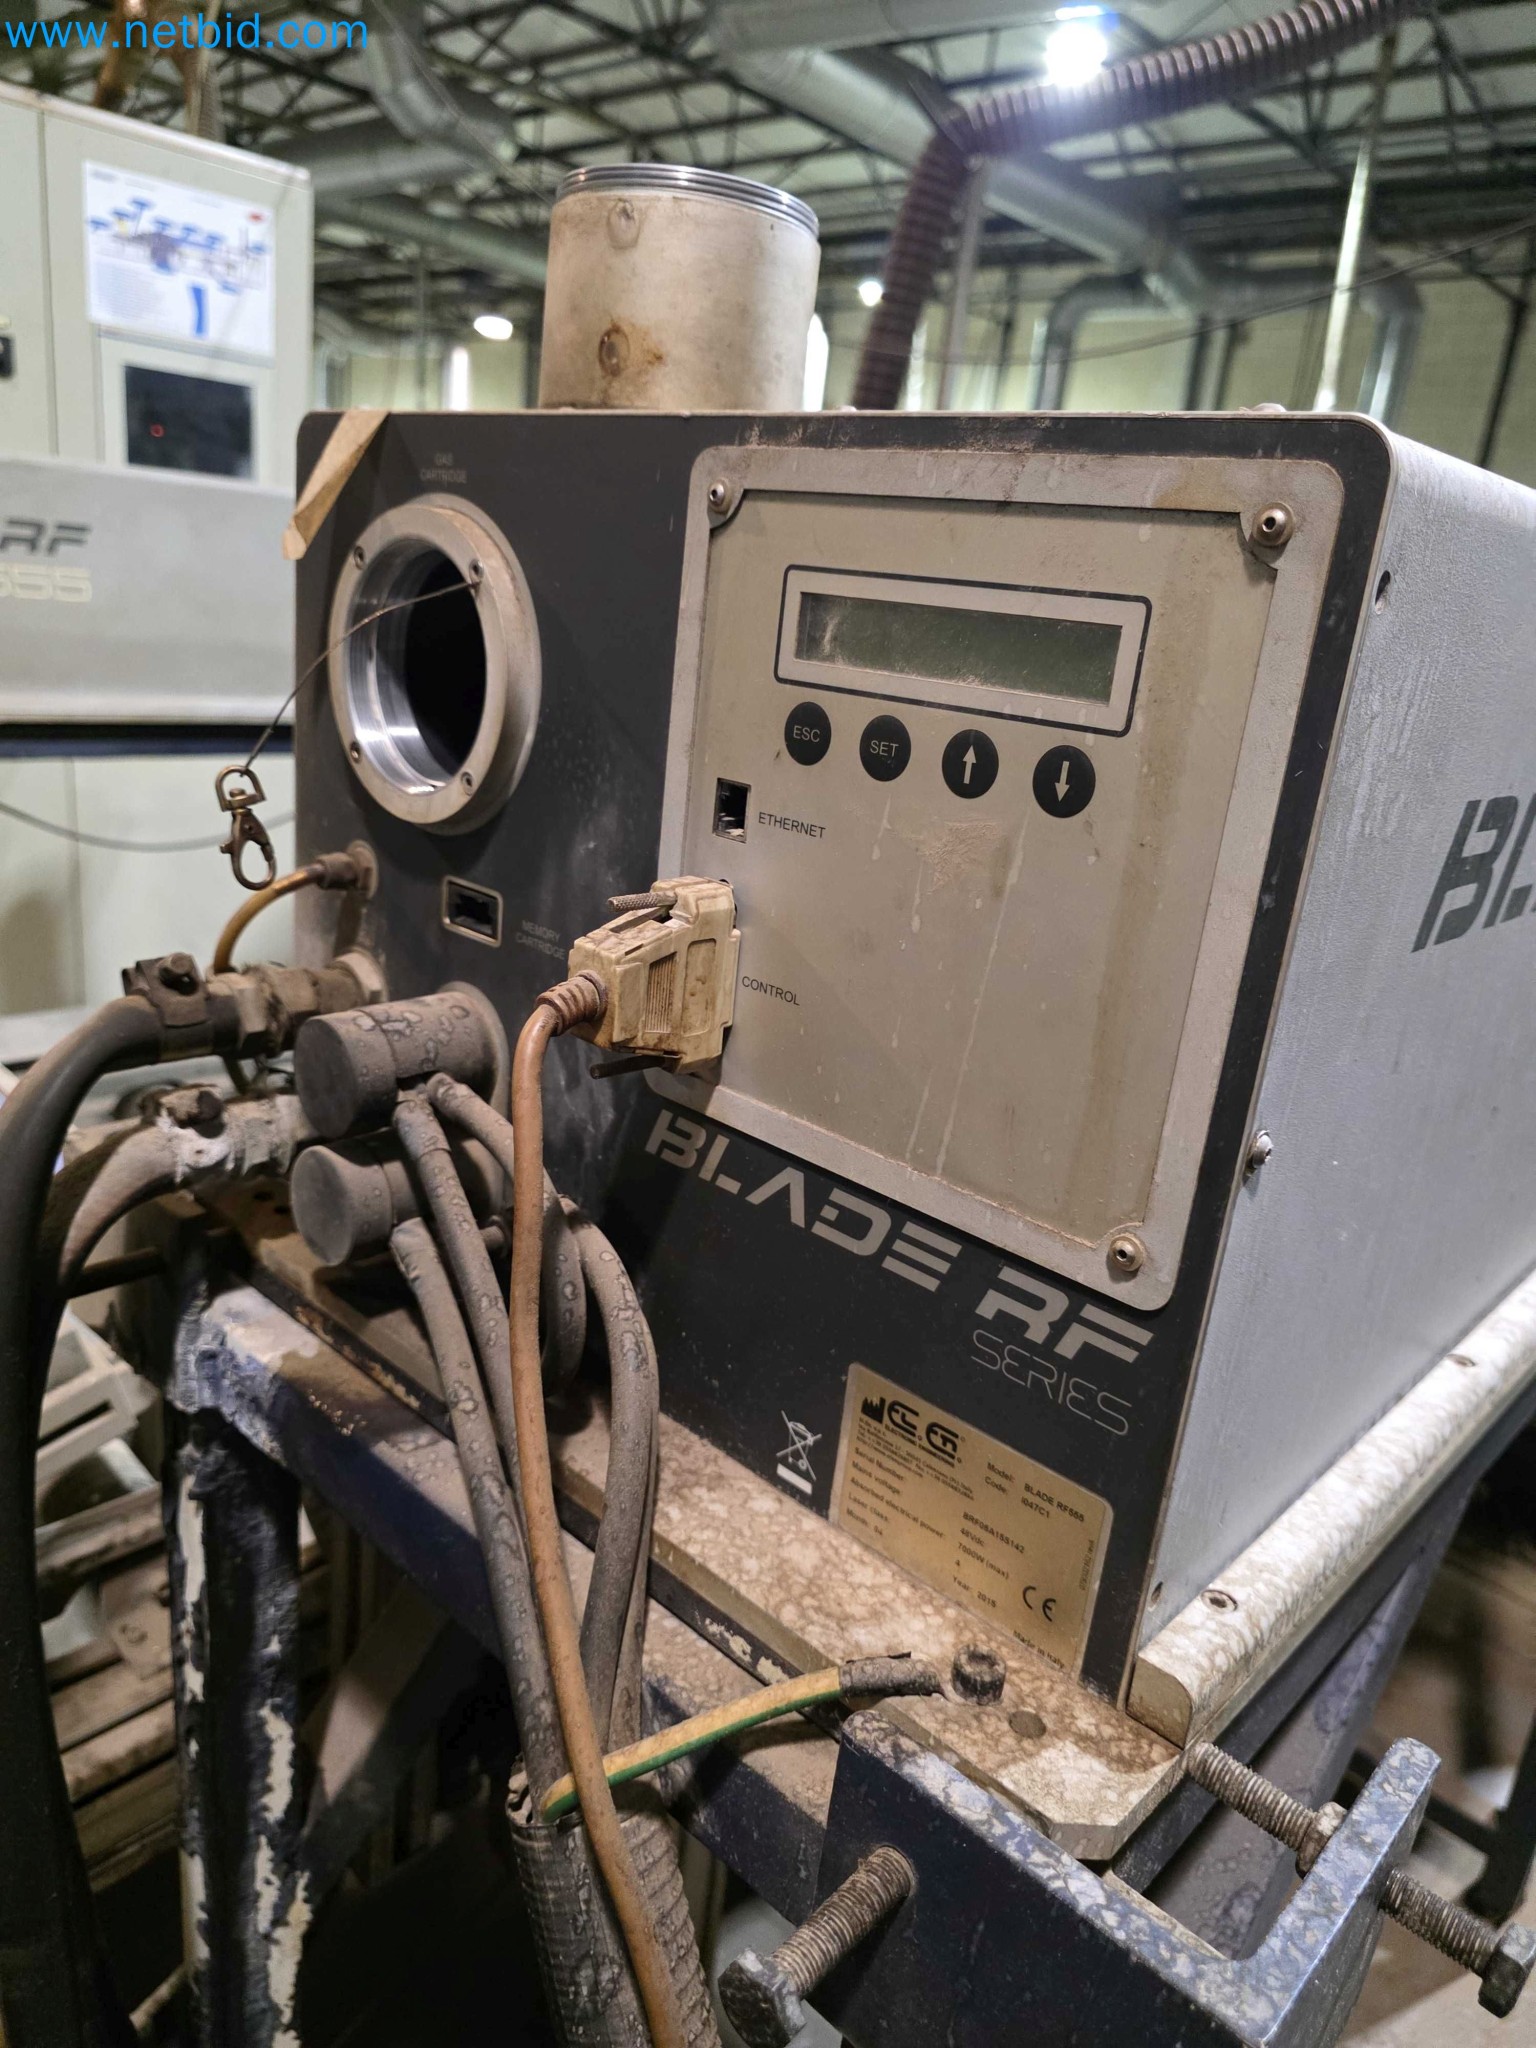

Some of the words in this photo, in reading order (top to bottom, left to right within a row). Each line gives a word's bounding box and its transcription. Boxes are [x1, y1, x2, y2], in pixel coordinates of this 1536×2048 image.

[793, 725, 821, 743] ESC
[870, 740, 898, 758] SET
[758, 811, 826, 839] ETHERNET
[1410, 792, 1536, 953] BL
[522, 920, 561, 942] MEMORY
[516, 932, 566, 960] CARTRIDGE
[742, 975, 800, 1006] CONTROL
[645, 1109, 962, 1293] BLADE
[974, 1265, 1154, 1364] RF
[971, 1329, 1133, 1436] SERIES
[986, 1461, 1015, 1484] Model:
[1023, 1482, 1054, 1506] BLADE
